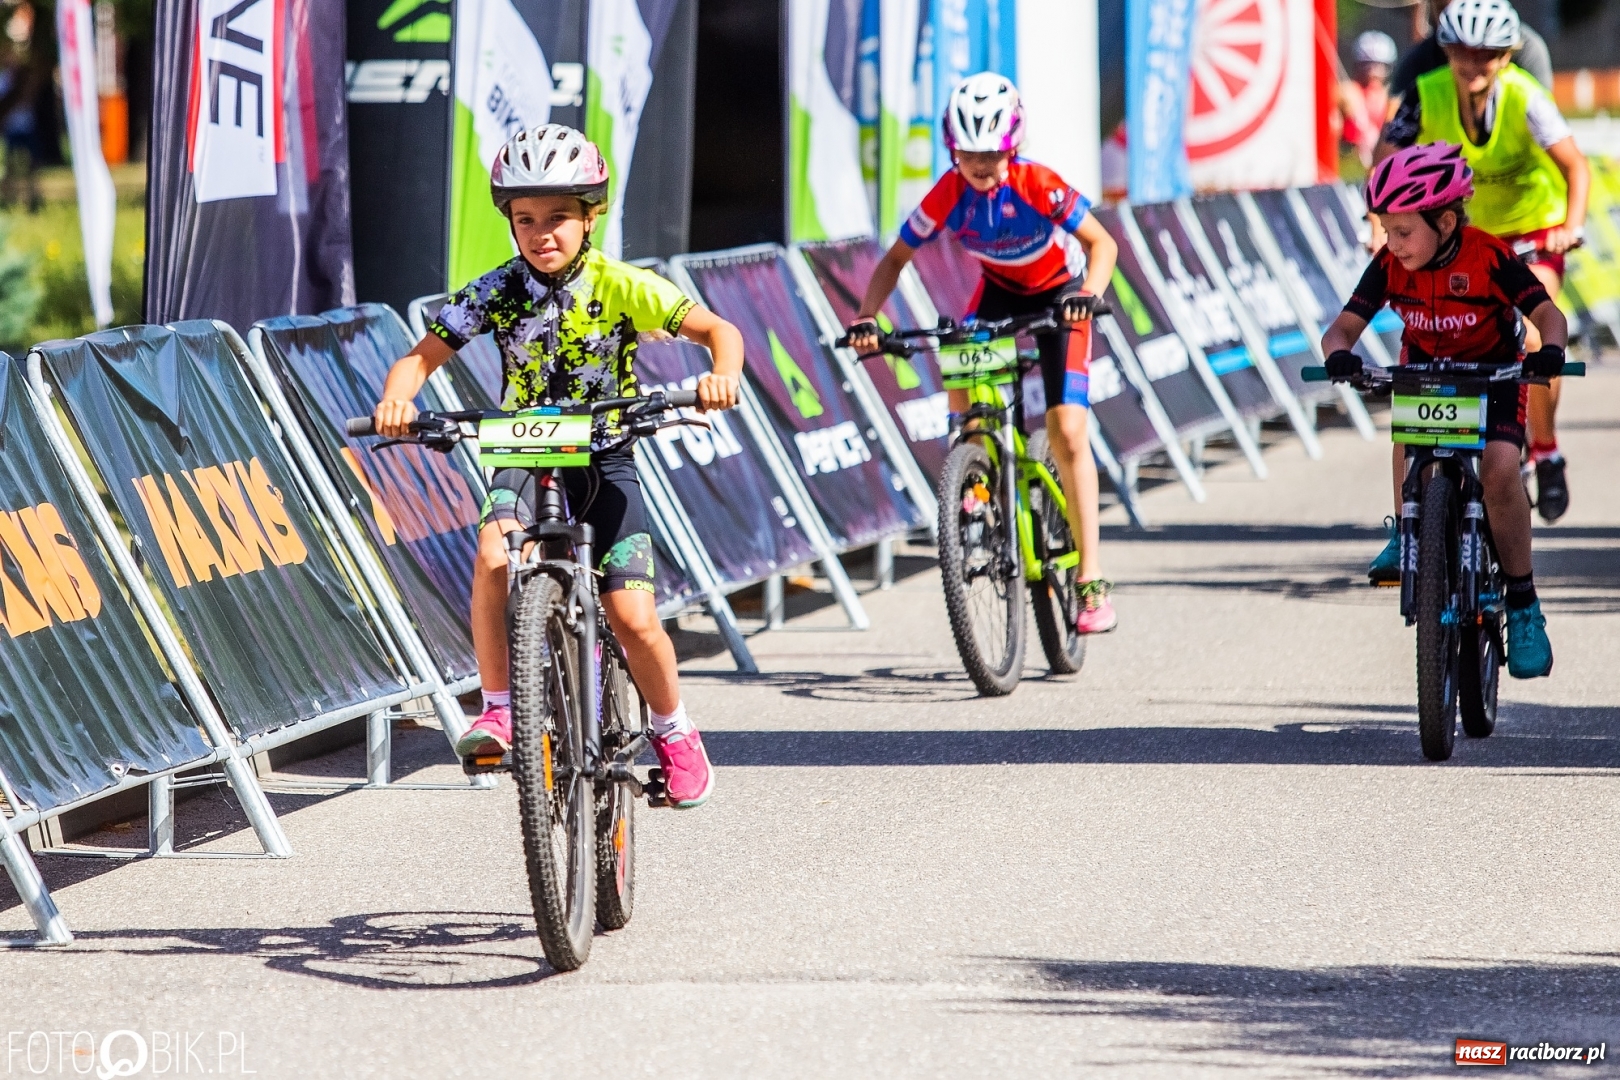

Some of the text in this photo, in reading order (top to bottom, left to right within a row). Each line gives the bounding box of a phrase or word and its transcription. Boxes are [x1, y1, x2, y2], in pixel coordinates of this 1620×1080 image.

[959, 348, 992, 366] 065
[1418, 403, 1457, 421] 063
[512, 421, 561, 438] 067
